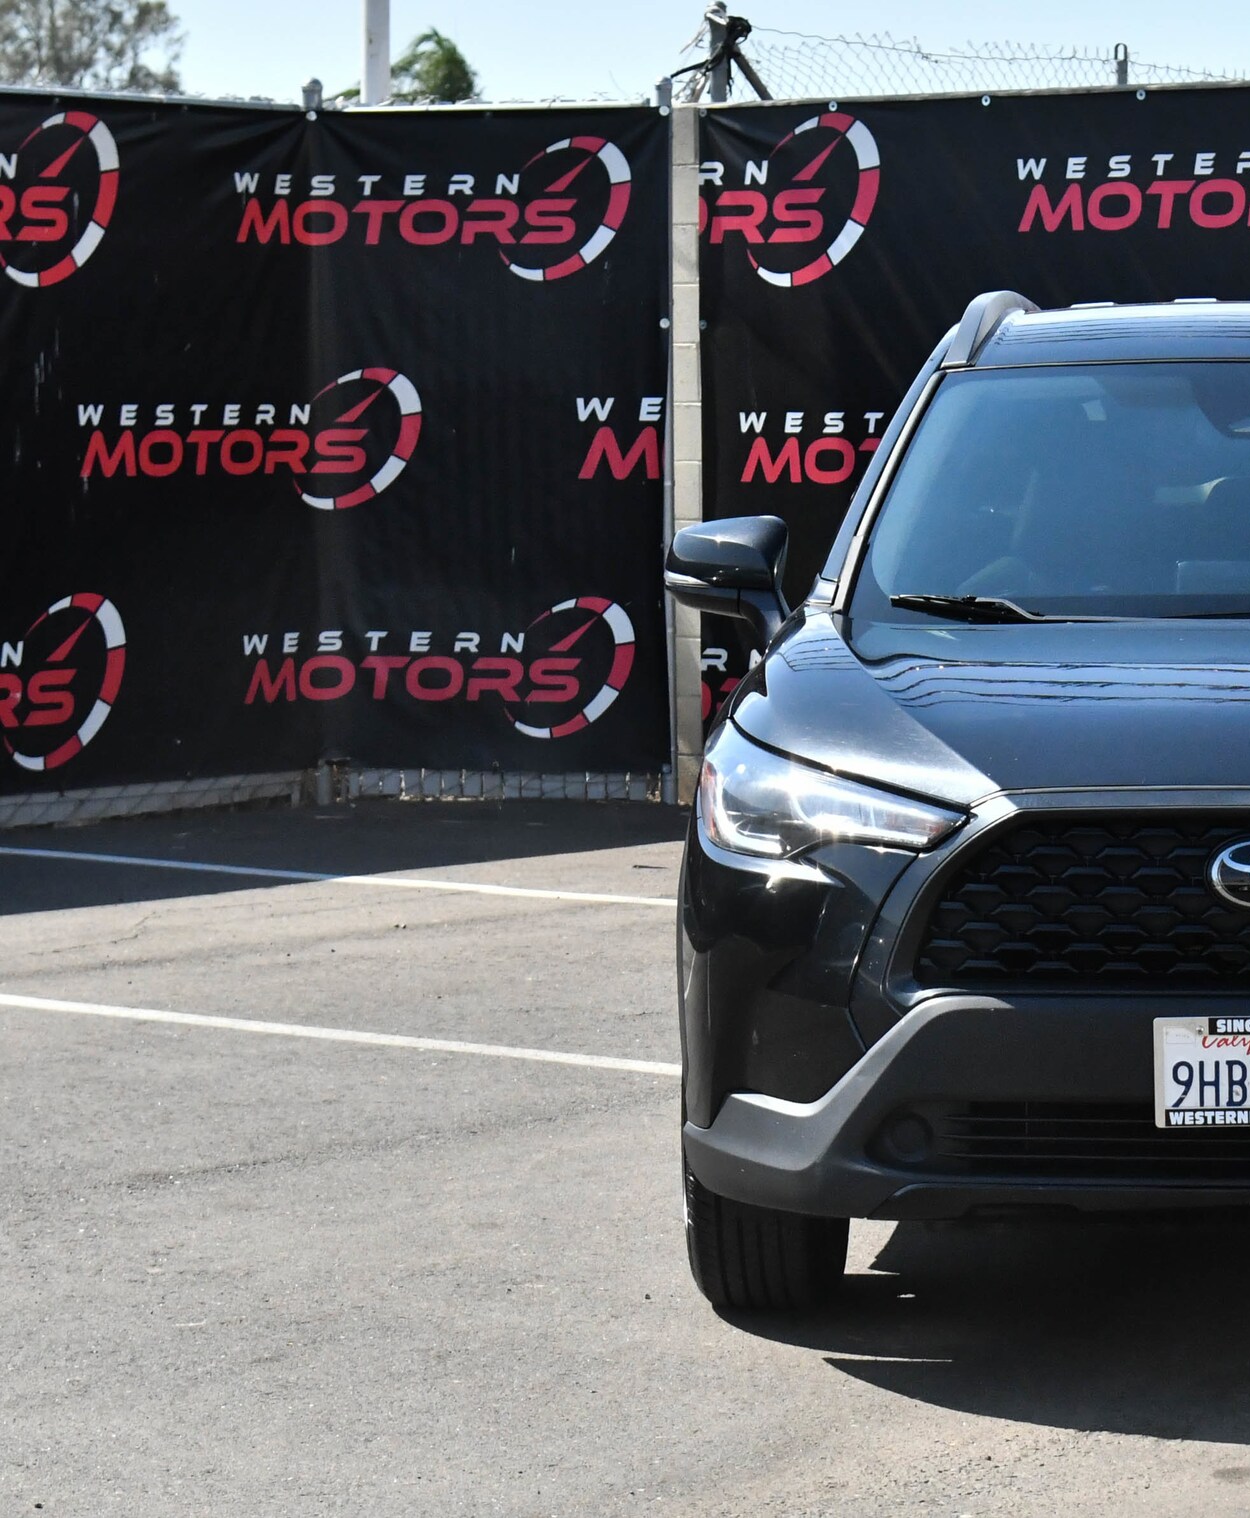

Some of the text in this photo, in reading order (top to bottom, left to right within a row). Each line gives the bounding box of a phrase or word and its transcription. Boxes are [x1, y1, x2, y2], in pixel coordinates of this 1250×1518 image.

[234, 172, 519, 195] WESTERN
[236, 198, 577, 245] MOTORS
[79, 404, 311, 426] WESTERN
[81, 429, 367, 478] MOTORS
[244, 631, 525, 655] WESTERN
[246, 656, 580, 703] MOTORS
